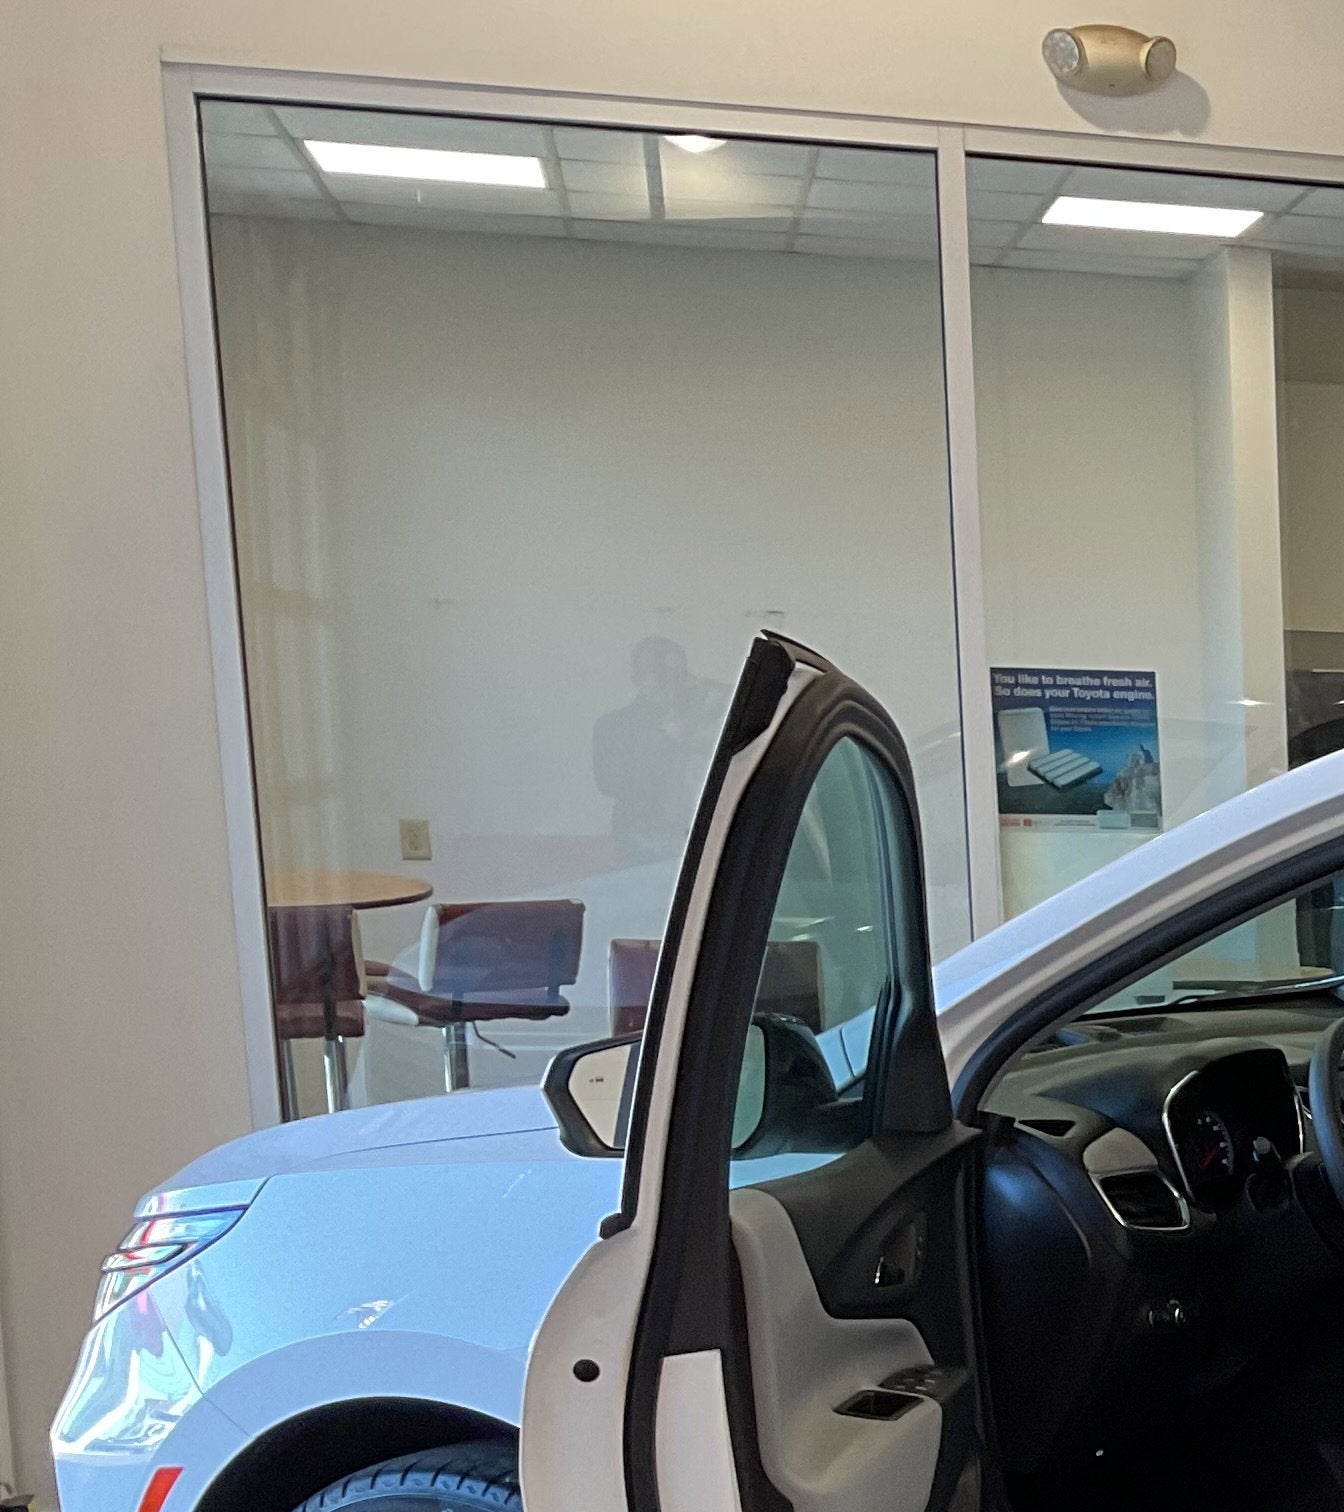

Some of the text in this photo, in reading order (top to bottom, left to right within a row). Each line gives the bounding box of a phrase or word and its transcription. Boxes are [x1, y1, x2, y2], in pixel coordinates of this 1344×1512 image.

[993, 673, 1153, 688] You like to breathe fresh air.
[994, 686, 1155, 702] So does your Toyota engine.
